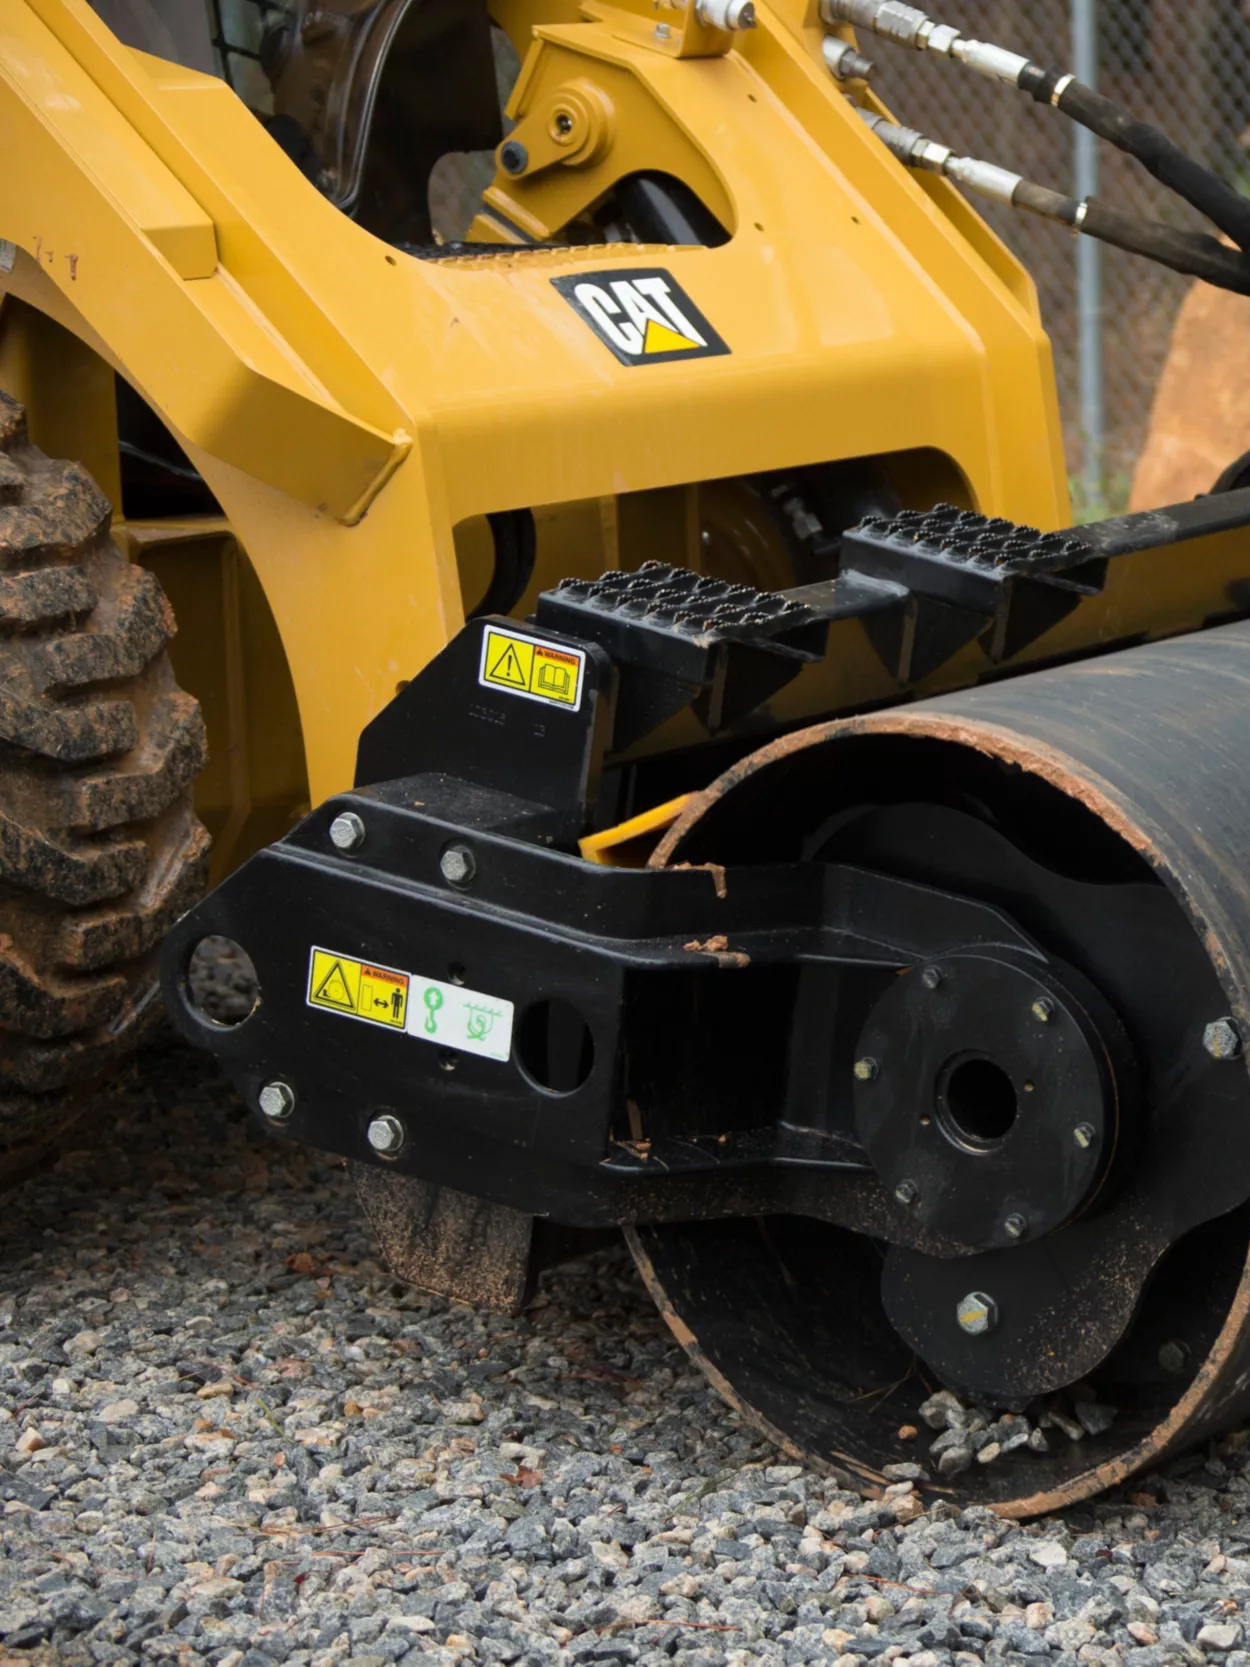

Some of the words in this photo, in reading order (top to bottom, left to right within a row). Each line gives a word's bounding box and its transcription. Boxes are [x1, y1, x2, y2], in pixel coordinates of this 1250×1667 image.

[574, 277, 708, 355] CAT
[544, 650, 576, 665] WARNING
[372, 970, 404, 985] WARNING
